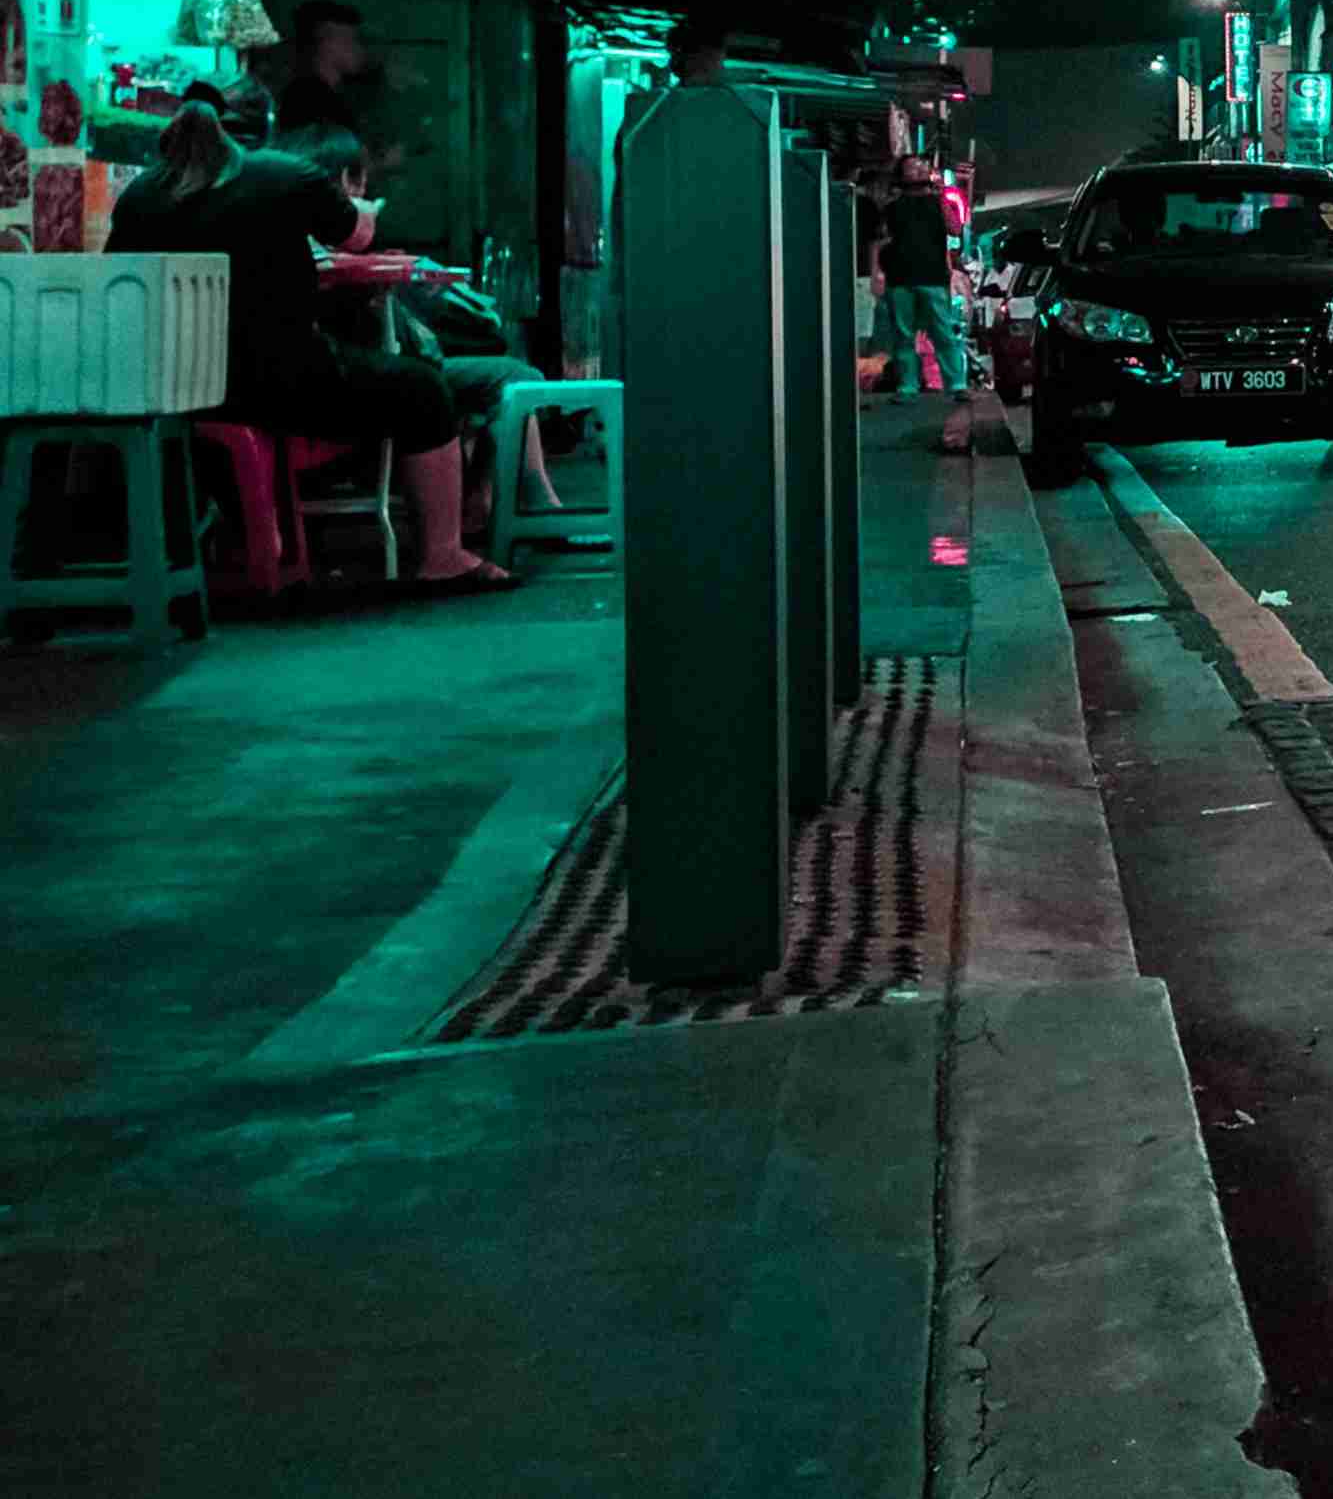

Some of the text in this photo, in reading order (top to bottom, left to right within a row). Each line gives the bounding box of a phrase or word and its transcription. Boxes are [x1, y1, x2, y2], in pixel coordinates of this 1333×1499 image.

[1233, 16, 1250, 100] HOTEL
[1200, 371, 1286, 390] WTV 3603
